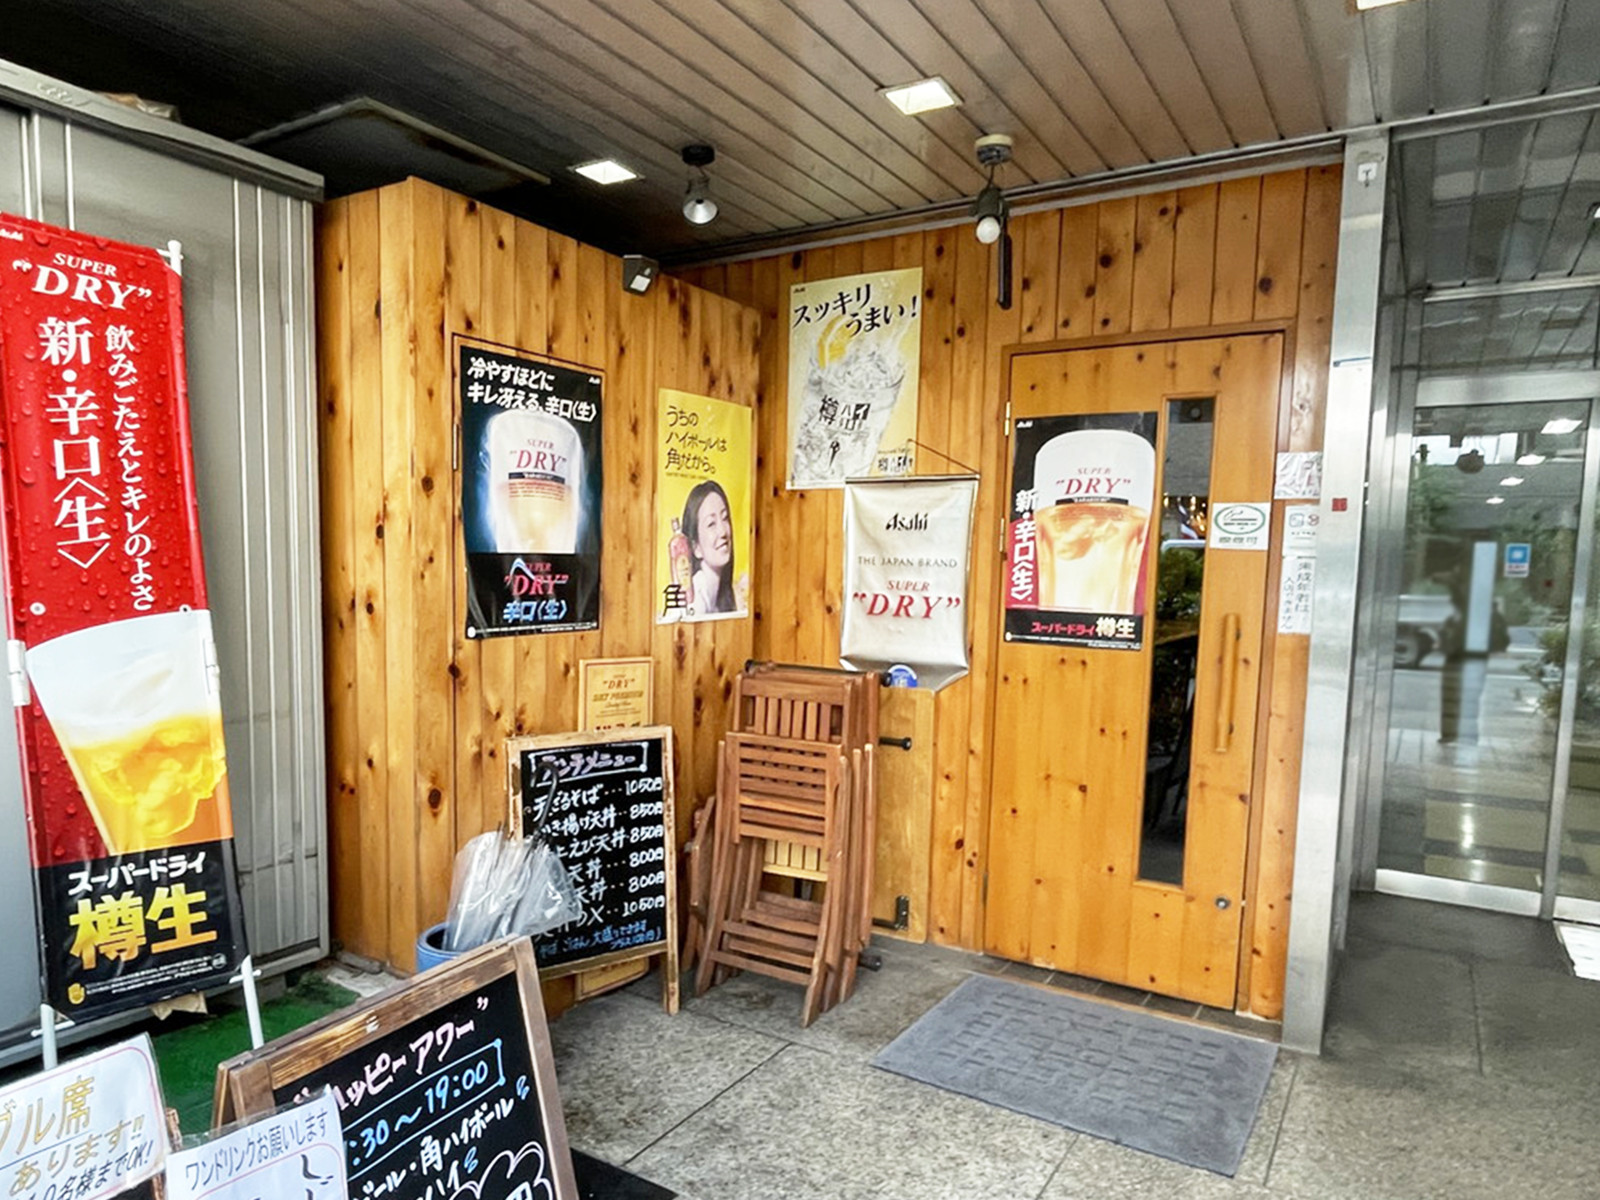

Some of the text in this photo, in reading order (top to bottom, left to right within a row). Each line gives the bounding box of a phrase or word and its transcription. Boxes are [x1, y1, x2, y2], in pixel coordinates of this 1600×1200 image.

[53, 252, 118, 278] SUPER
[792, 283, 871, 329] スッキリ
[845, 295, 917, 339] うまい!
[467, 356, 556, 391] 冷やすほどに
[666, 405, 699, 427] うちの
[665, 432, 728, 452] ハイボールは
[104, 323, 155, 612] 飲みごたえとキレのよさ
[665, 447, 716, 474] 角だから。
[885, 513, 928, 531] Asahi
[858, 556, 958, 569] THE JAPAN BRAND
[887, 580, 930, 592] SUPER
[1031, 616, 1136, 638] スーパードライ 樽生
[630, 802, 663, 819] 850円
[630, 825, 664, 843] 850円
[629, 847, 664, 867] 800円
[68, 852, 206, 896] スーパードライ
[628, 871, 665, 893] 800円
[69, 883, 218, 970] 樽生
[185, 1108, 328, 1191] ワンドリンクお願いします
